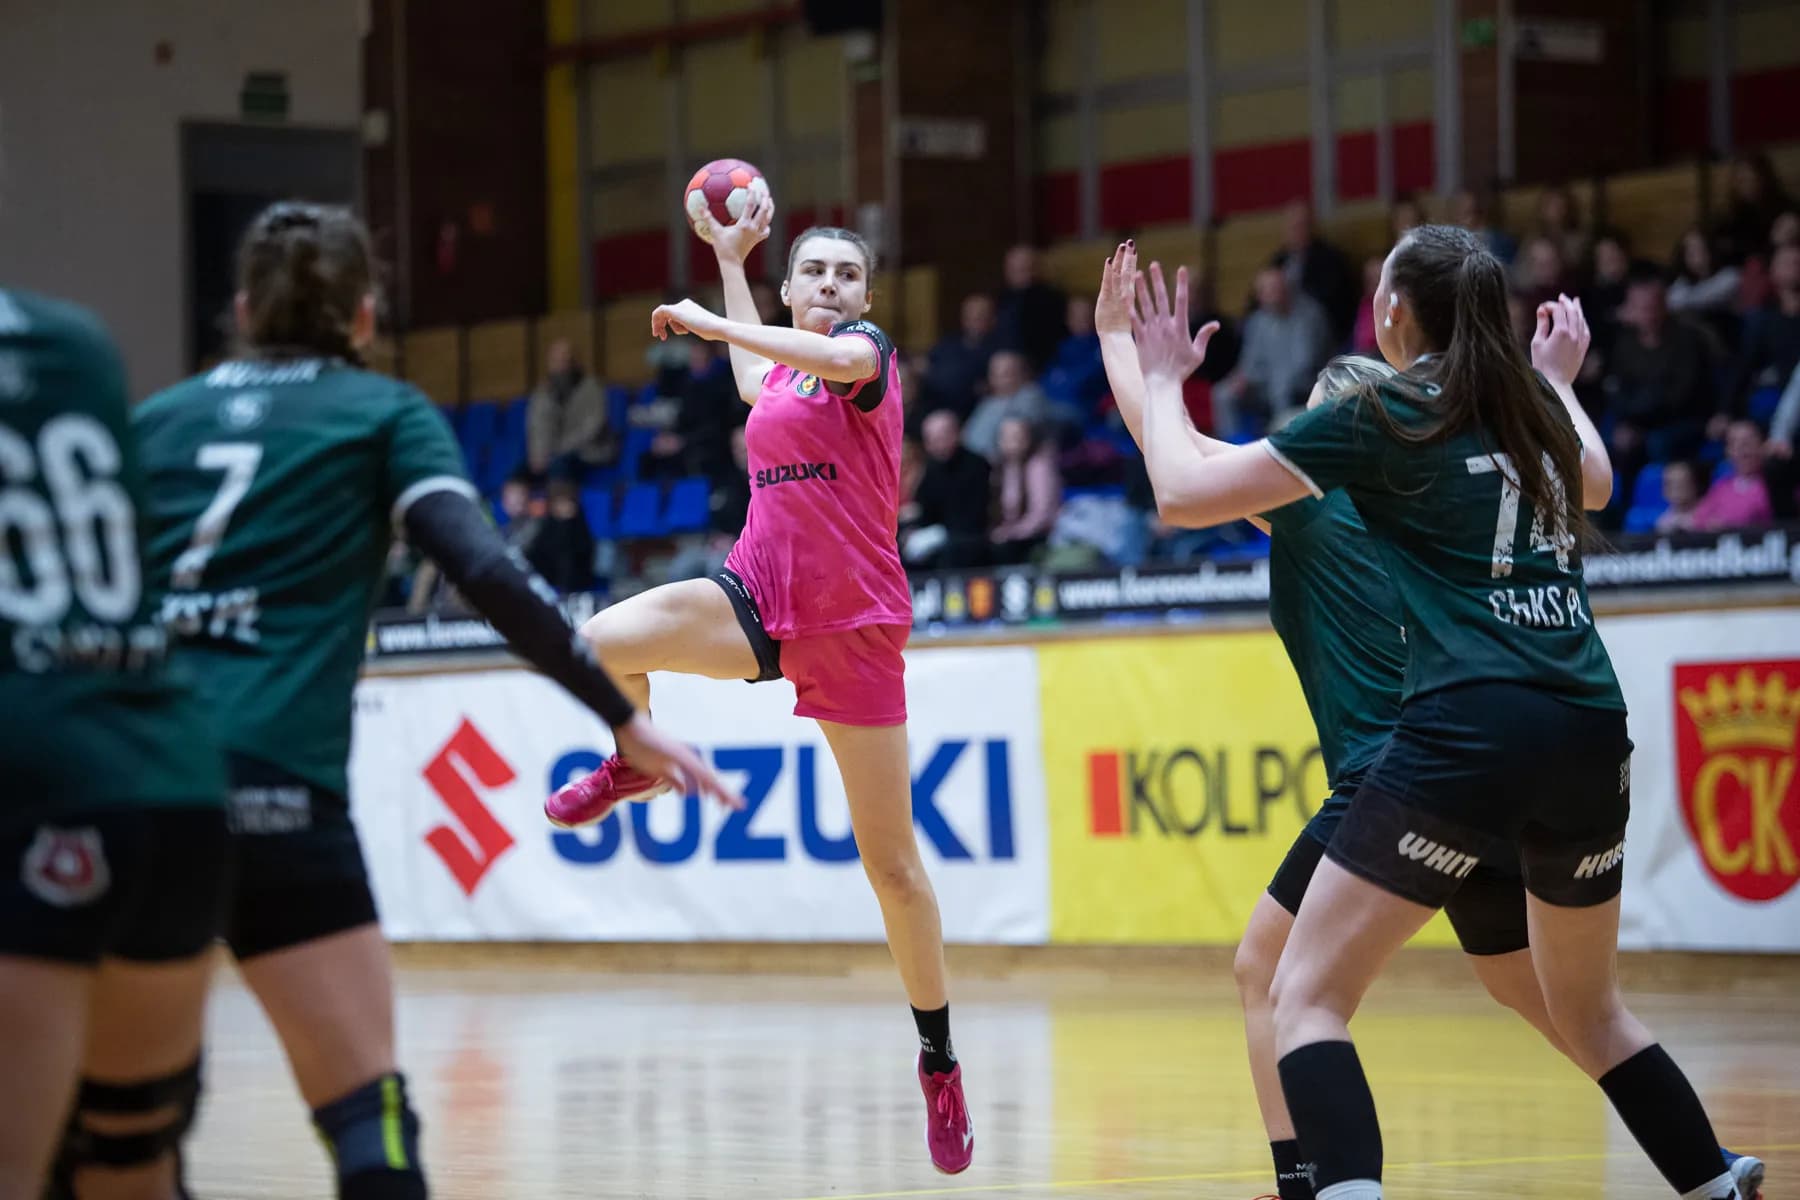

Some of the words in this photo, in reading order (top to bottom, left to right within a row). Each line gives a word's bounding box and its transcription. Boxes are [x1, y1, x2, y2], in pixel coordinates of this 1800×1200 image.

[171, 442, 264, 588] 7
[756, 462, 838, 489] SUZUKI
[0, 412, 142, 626] 66
[548, 737, 1017, 867] SUZUKI
[1692, 752, 1798, 876] CK
[1398, 831, 1480, 879] WHIT
[1573, 838, 1626, 879] HAR
[1280, 1171, 1313, 1181] PIOTR
